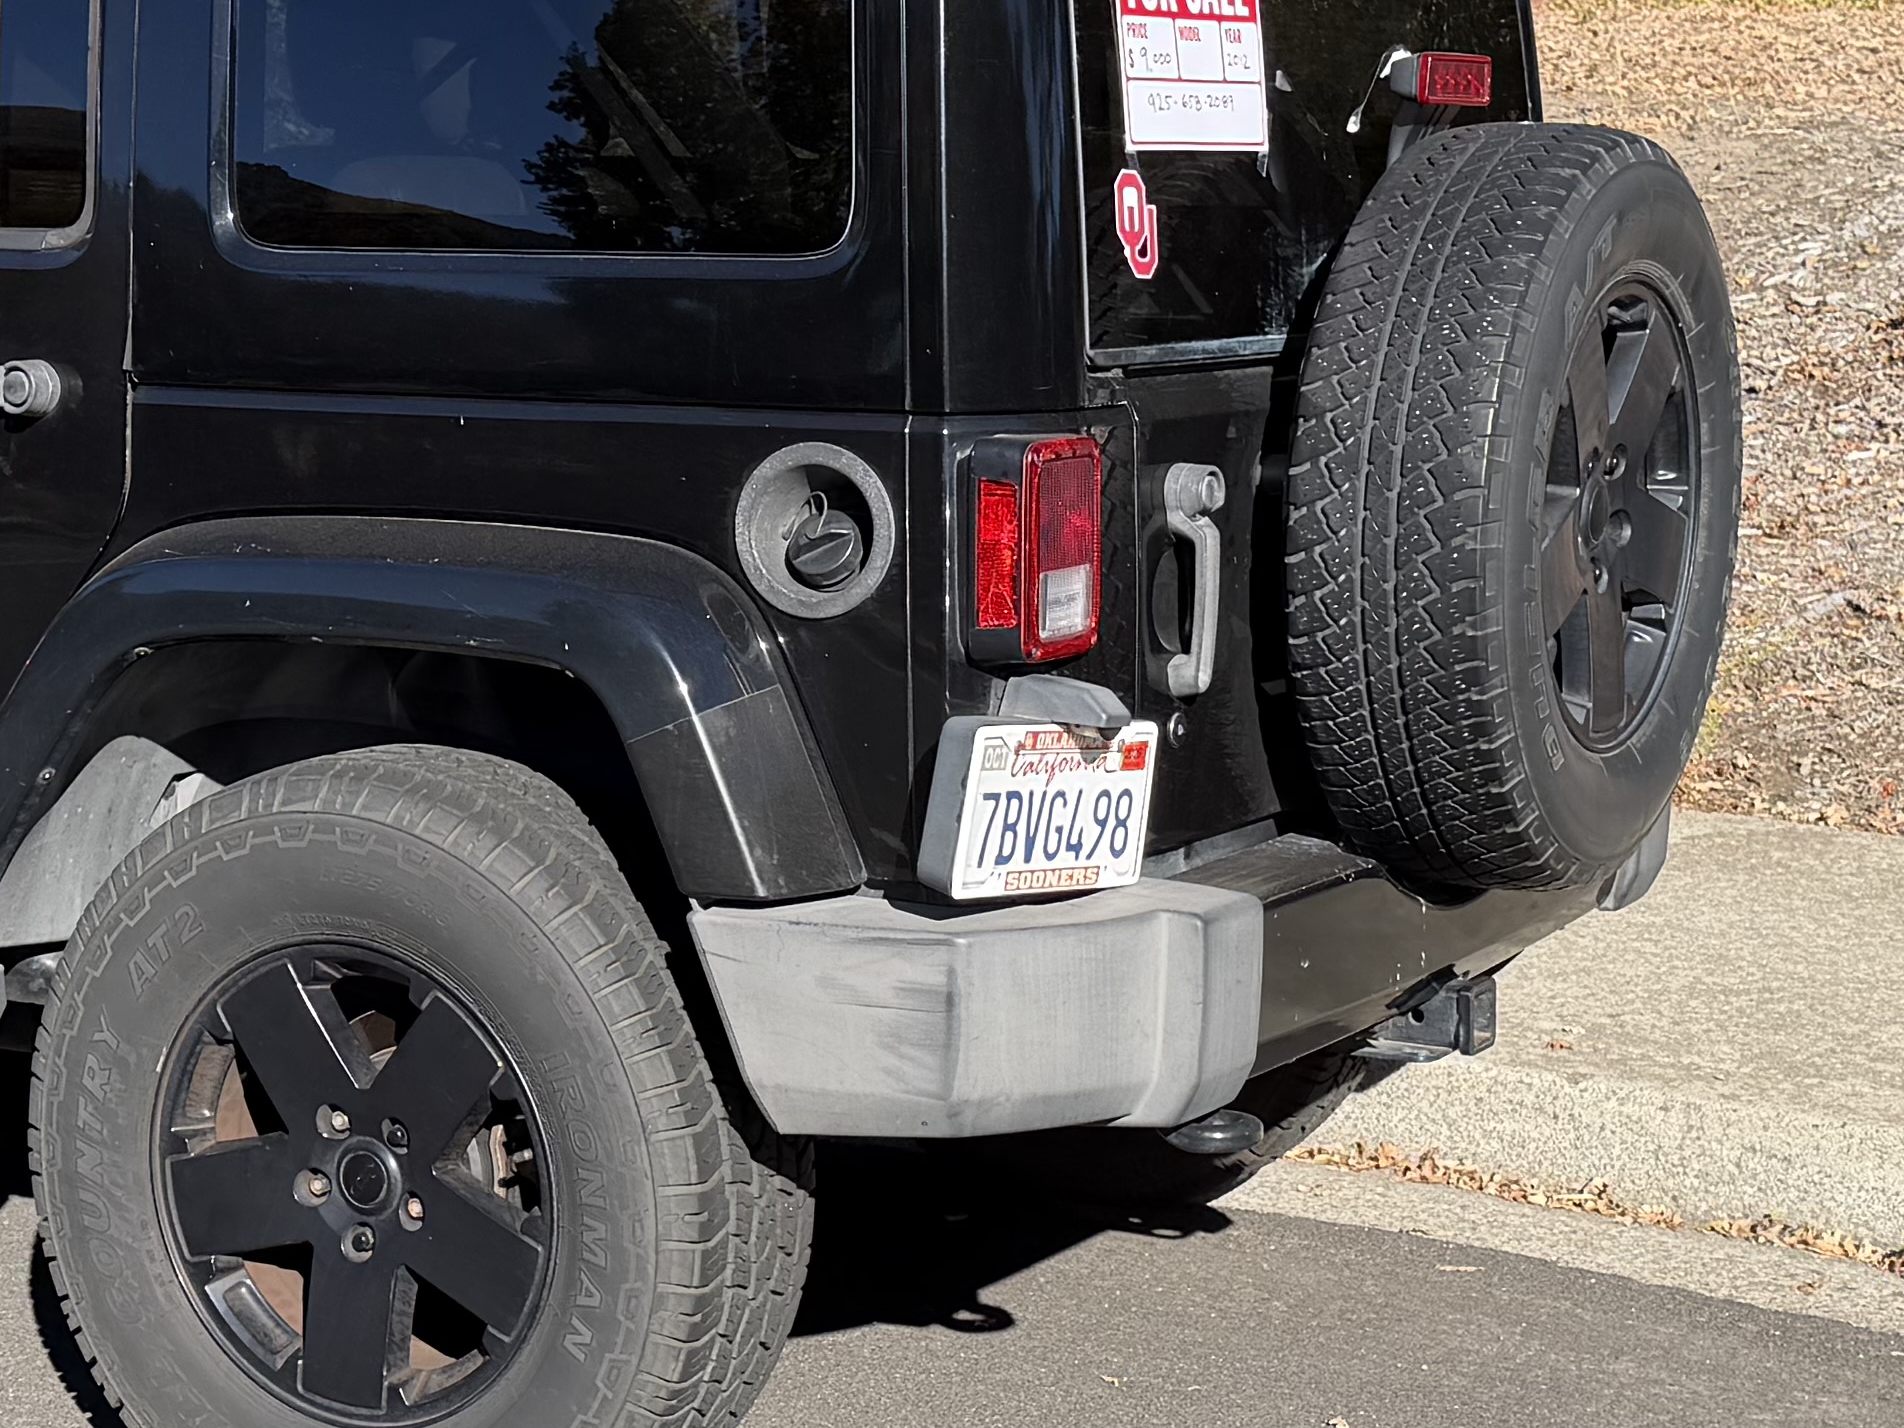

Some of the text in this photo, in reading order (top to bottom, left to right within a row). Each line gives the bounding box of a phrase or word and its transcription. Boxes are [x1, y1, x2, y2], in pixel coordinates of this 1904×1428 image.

[1127, 22, 1148, 39] PRICE
[1225, 28, 1241, 44] YEAR
[984, 747, 1007, 769] OCT
[977, 787, 1134, 869] 7BVG498
[1005, 866, 1099, 891] SOONERS
[127, 901, 206, 1002] AT2
[541, 1050, 615, 1366] IRONMAN
